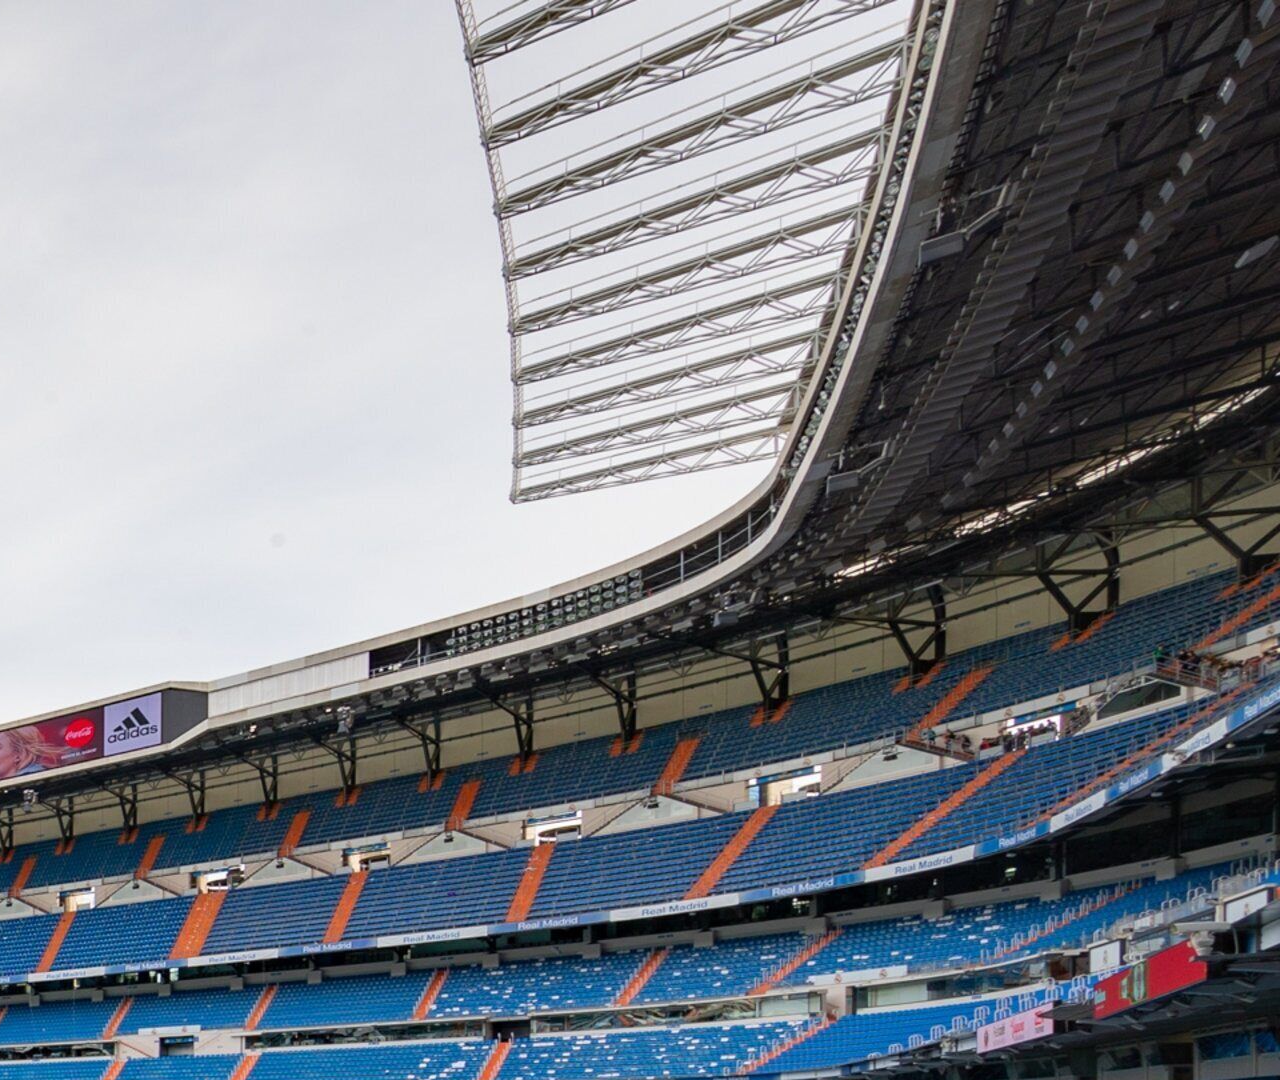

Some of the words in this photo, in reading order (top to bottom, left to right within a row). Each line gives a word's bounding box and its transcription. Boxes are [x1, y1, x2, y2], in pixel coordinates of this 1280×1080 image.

[107, 724, 159, 744] adidas
[998, 837, 1016, 849] Real
[1017, 829, 1036, 844] Madrid
[894, 864, 917, 875] Real
[918, 855, 953, 870] Madrid
[771, 886, 797, 897] Real
[798, 877, 834, 893] Madrid
[642, 906, 666, 917] Real
[668, 901, 709, 913] Madrid
[517, 921, 540, 931] Real
[542, 916, 578, 928] Madrid
[403, 936, 425, 944] Real
[426, 931, 460, 941] Madrid
[302, 944, 321, 953] Real
[322, 941, 352, 951] Madrid
[142, 961, 167, 969] Madrid
[228, 953, 256, 962] Madrid
